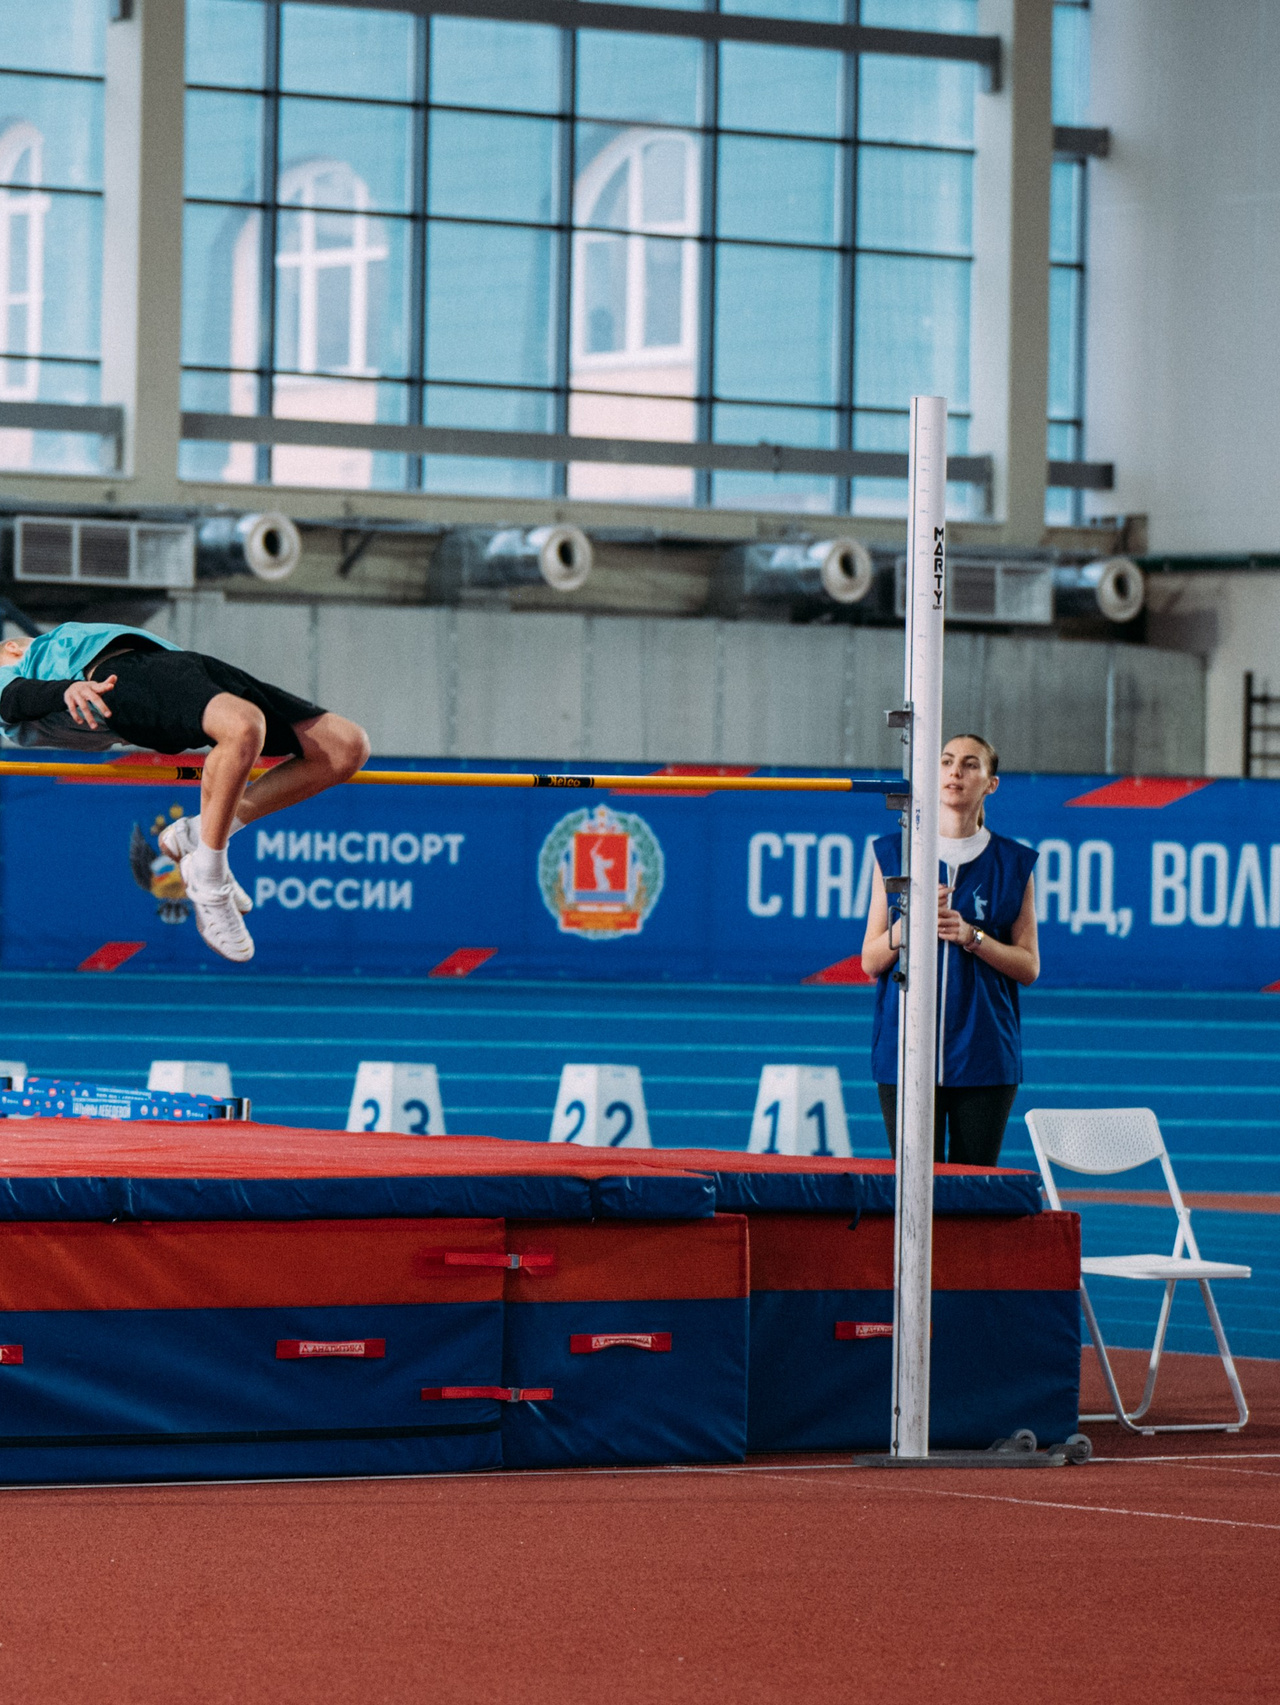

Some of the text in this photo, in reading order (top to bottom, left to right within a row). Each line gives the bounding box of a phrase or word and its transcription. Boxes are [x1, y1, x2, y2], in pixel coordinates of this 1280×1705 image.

[933, 527, 945, 604] MARTY
[256, 829, 464, 865] МИНСПОРТ
[255, 877, 413, 911] РОССИИ
[761, 1100, 781, 1154] 1
[806, 1101, 834, 1156] 1
